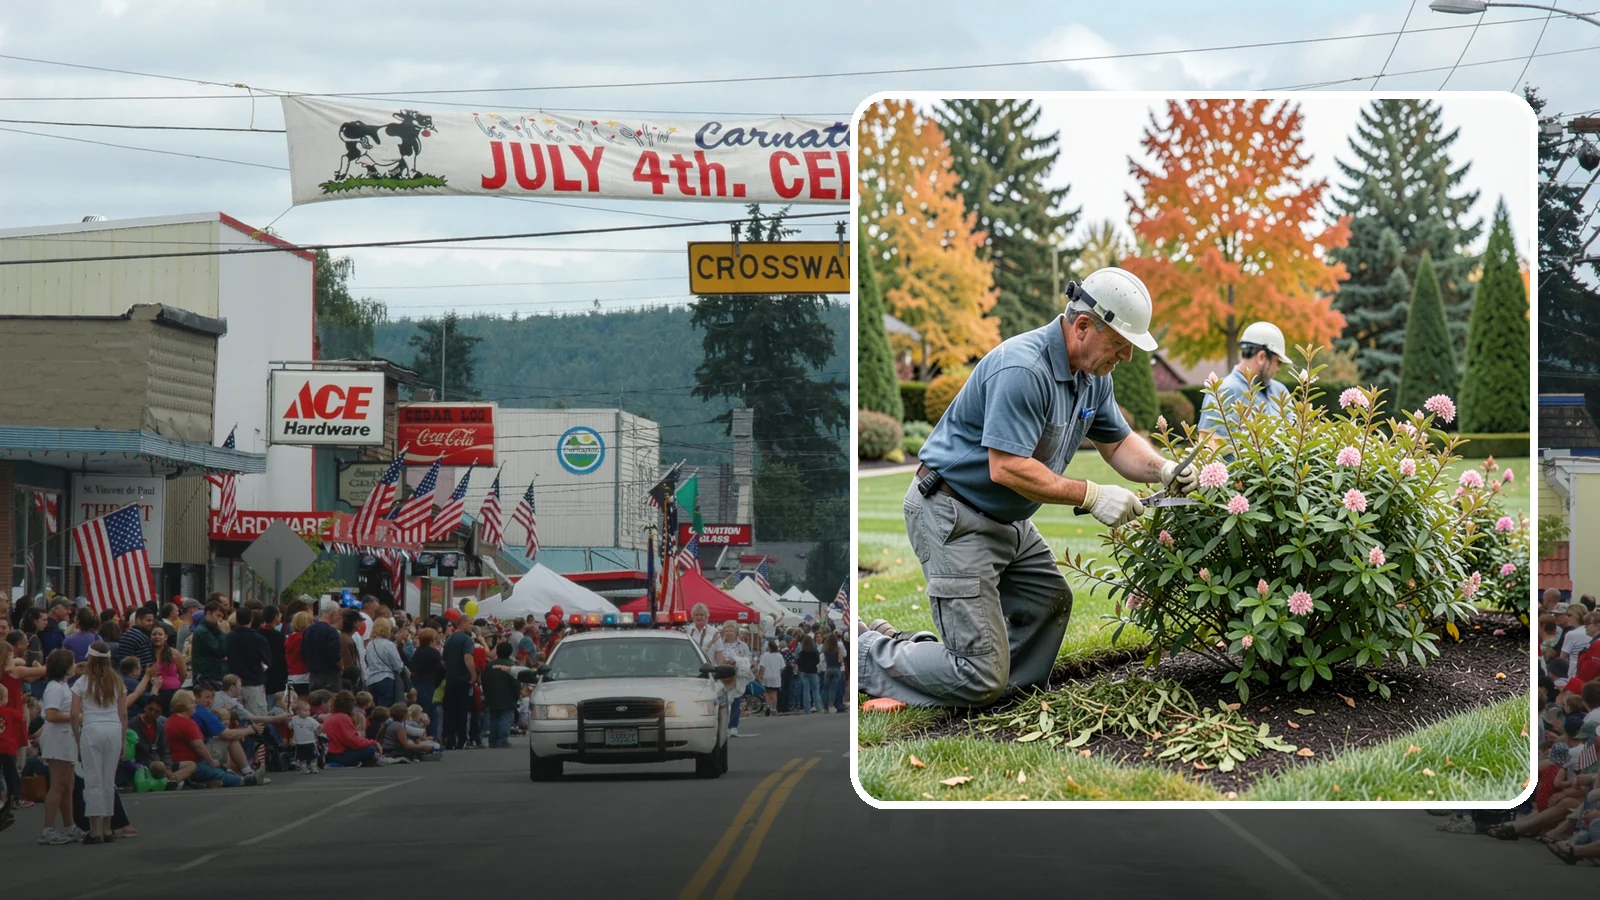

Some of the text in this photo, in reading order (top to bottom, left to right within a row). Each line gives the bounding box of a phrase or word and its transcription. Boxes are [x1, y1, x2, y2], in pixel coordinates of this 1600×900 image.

[481, 140, 605, 193] JULY
[632, 150, 746, 197] 4th.
[697, 254, 850, 280] CROSSWA
[282, 380, 374, 420] ACE
[405, 409, 453, 422] CEDAR
[283, 421, 371, 436] Hardware
[416, 428, 477, 447] Coca-Cola
[354, 467, 387, 480] Simpl
[83, 485, 155, 495] St. Vincent de Paul
[212, 516, 331, 536] HARDARE
[687, 526, 741, 535] CRNATION
[699, 535, 730, 543] GLASS
